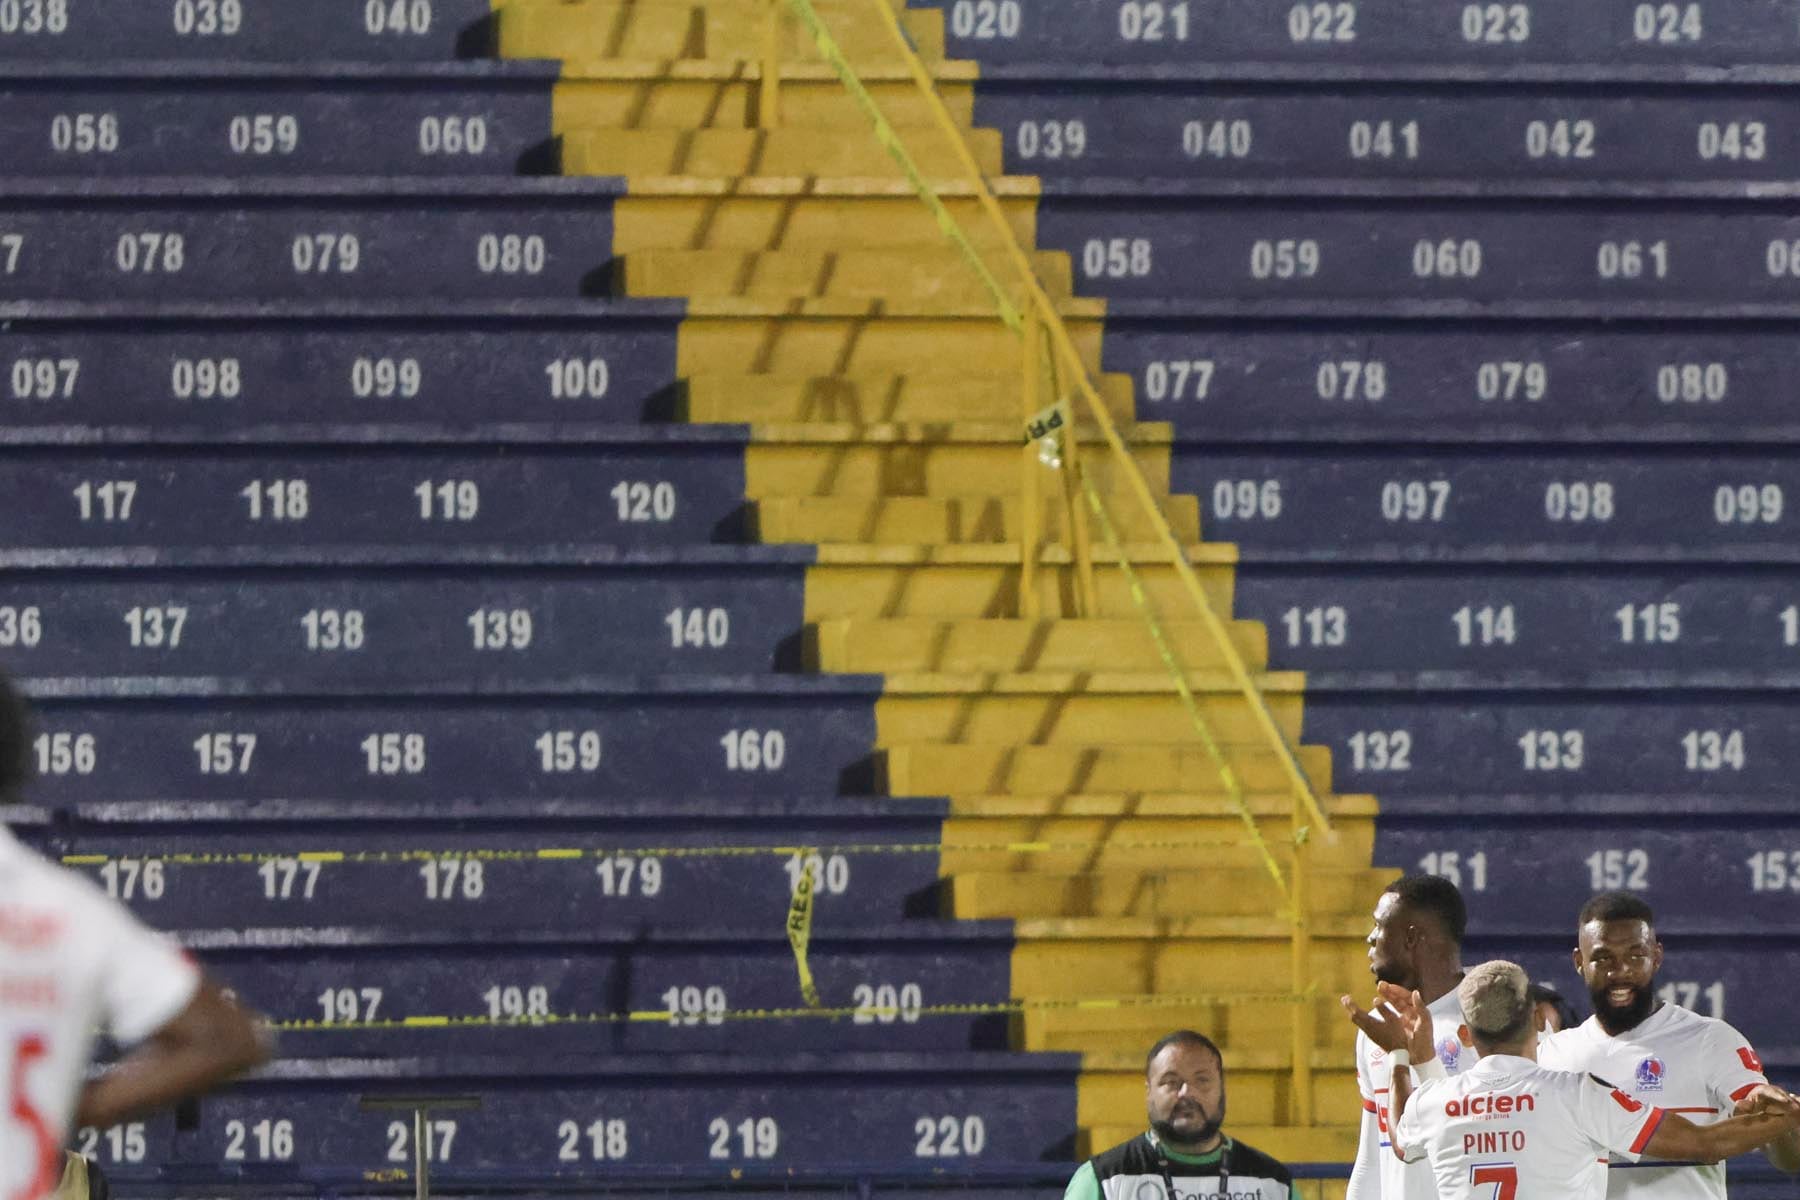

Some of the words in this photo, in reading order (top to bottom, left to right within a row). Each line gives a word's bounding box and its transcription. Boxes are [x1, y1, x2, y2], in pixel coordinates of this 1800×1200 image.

[0, 0, 68, 33] 038
[173, 0, 242, 35] 039
[364, 0, 432, 35] 040
[1119, 1, 1189, 40] 021
[1288, 2, 1356, 42] 022
[1634, 3, 1702, 43] 024
[50, 113, 119, 153] 058
[419, 116, 487, 154] 060
[1017, 120, 1086, 158] 039
[1349, 121, 1419, 158] 041
[1526, 119, 1595, 158] 042
[291, 233, 360, 272] 079
[477, 234, 545, 274] 080
[1250, 239, 1320, 278] 059
[1412, 239, 1482, 277] 060
[11, 358, 80, 399] 097
[171, 358, 241, 398] 098
[545, 358, 609, 398] 100
[1145, 360, 1215, 401] 077
[1316, 360, 1386, 401] 078
[1657, 363, 1727, 402] 080
[241, 479, 309, 520] 118
[414, 479, 479, 520] 119
[610, 480, 676, 522] 120
[1381, 480, 1451, 521] 097
[1545, 481, 1614, 522] 098
[124, 605, 188, 647] 137
[300, 608, 365, 650] 138
[664, 607, 729, 648] 140
[1282, 605, 1347, 647] 113
[1615, 602, 1681, 643] 115
[32, 732, 96, 775] 156
[360, 732, 426, 775] 158
[534, 730, 602, 772] 159
[1348, 729, 1412, 771] 132
[1517, 729, 1584, 770] 133
[100, 858, 165, 899] 176
[257, 856, 322, 899] 177
[419, 858, 484, 900] 178
[595, 856, 663, 897] 179
[1585, 848, 1649, 891] 152
[317, 987, 383, 1025] 197
[852, 983, 923, 1025] 200
[1445, 1091, 1535, 1117] alcien
[224, 1118, 294, 1161] 216
[557, 1118, 628, 1162] 218
[708, 1116, 779, 1159] 219
[1463, 1130, 1525, 1154] PINTO
